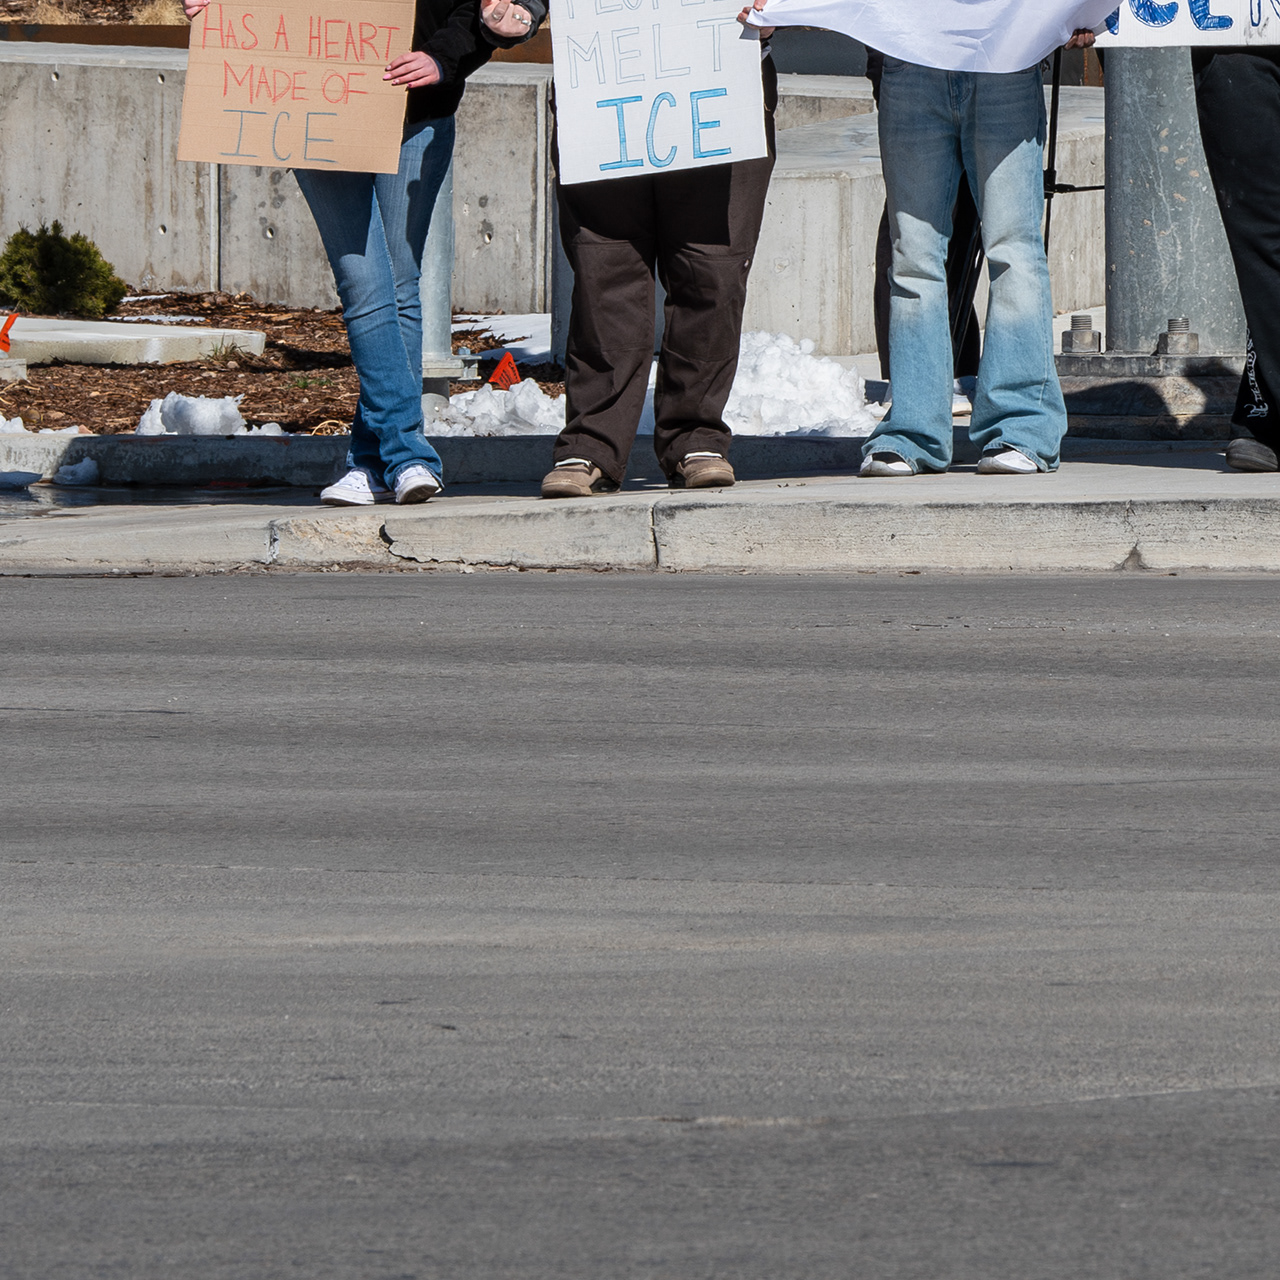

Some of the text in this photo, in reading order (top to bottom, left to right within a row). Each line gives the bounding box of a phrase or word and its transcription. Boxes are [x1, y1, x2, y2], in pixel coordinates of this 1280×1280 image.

[202, 3, 401, 63] HAS A HEART
[567, 16, 737, 89] MELT
[223, 59, 369, 105] MADE OF
[218, 109, 339, 163] ICE
[596, 87, 732, 171] ICE
